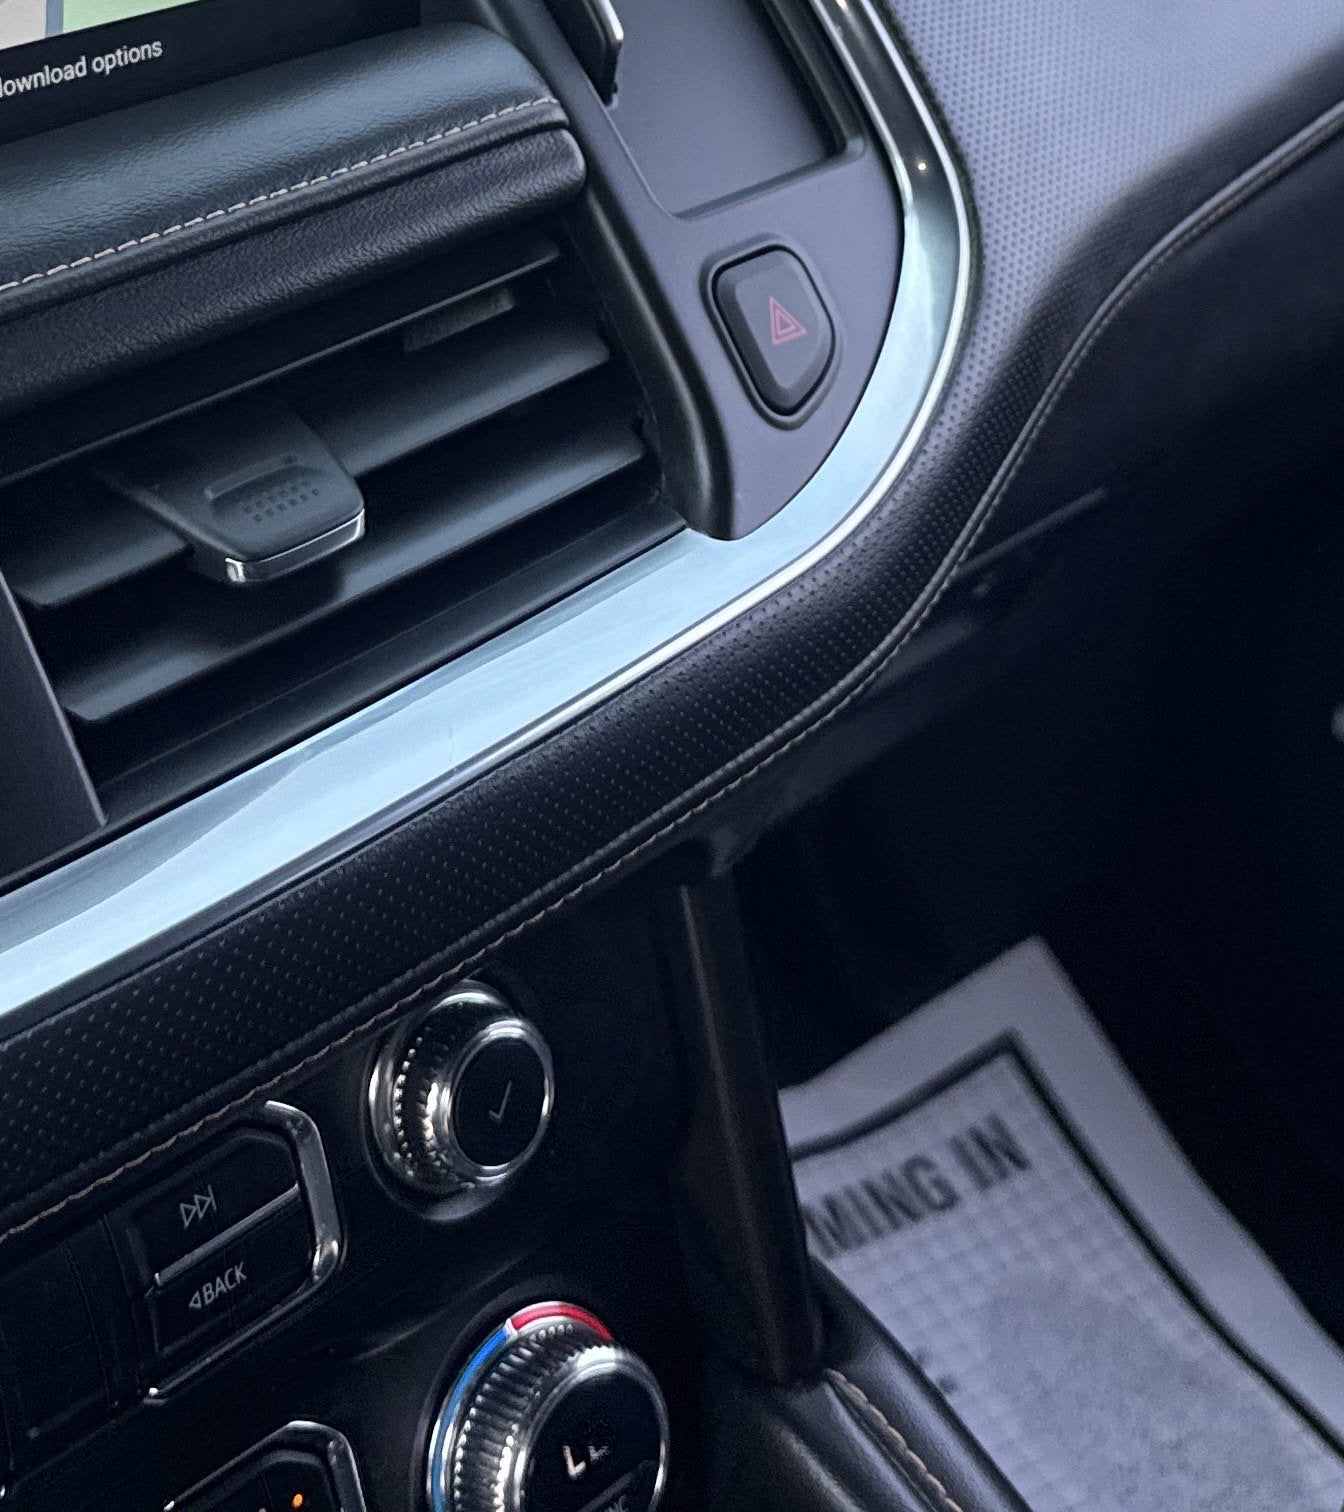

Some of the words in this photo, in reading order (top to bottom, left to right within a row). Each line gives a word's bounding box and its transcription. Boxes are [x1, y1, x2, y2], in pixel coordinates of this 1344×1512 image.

[92, 38, 164, 78] options
[949, 1110, 1032, 1190] IN
[202, 1260, 248, 1305] BACK
